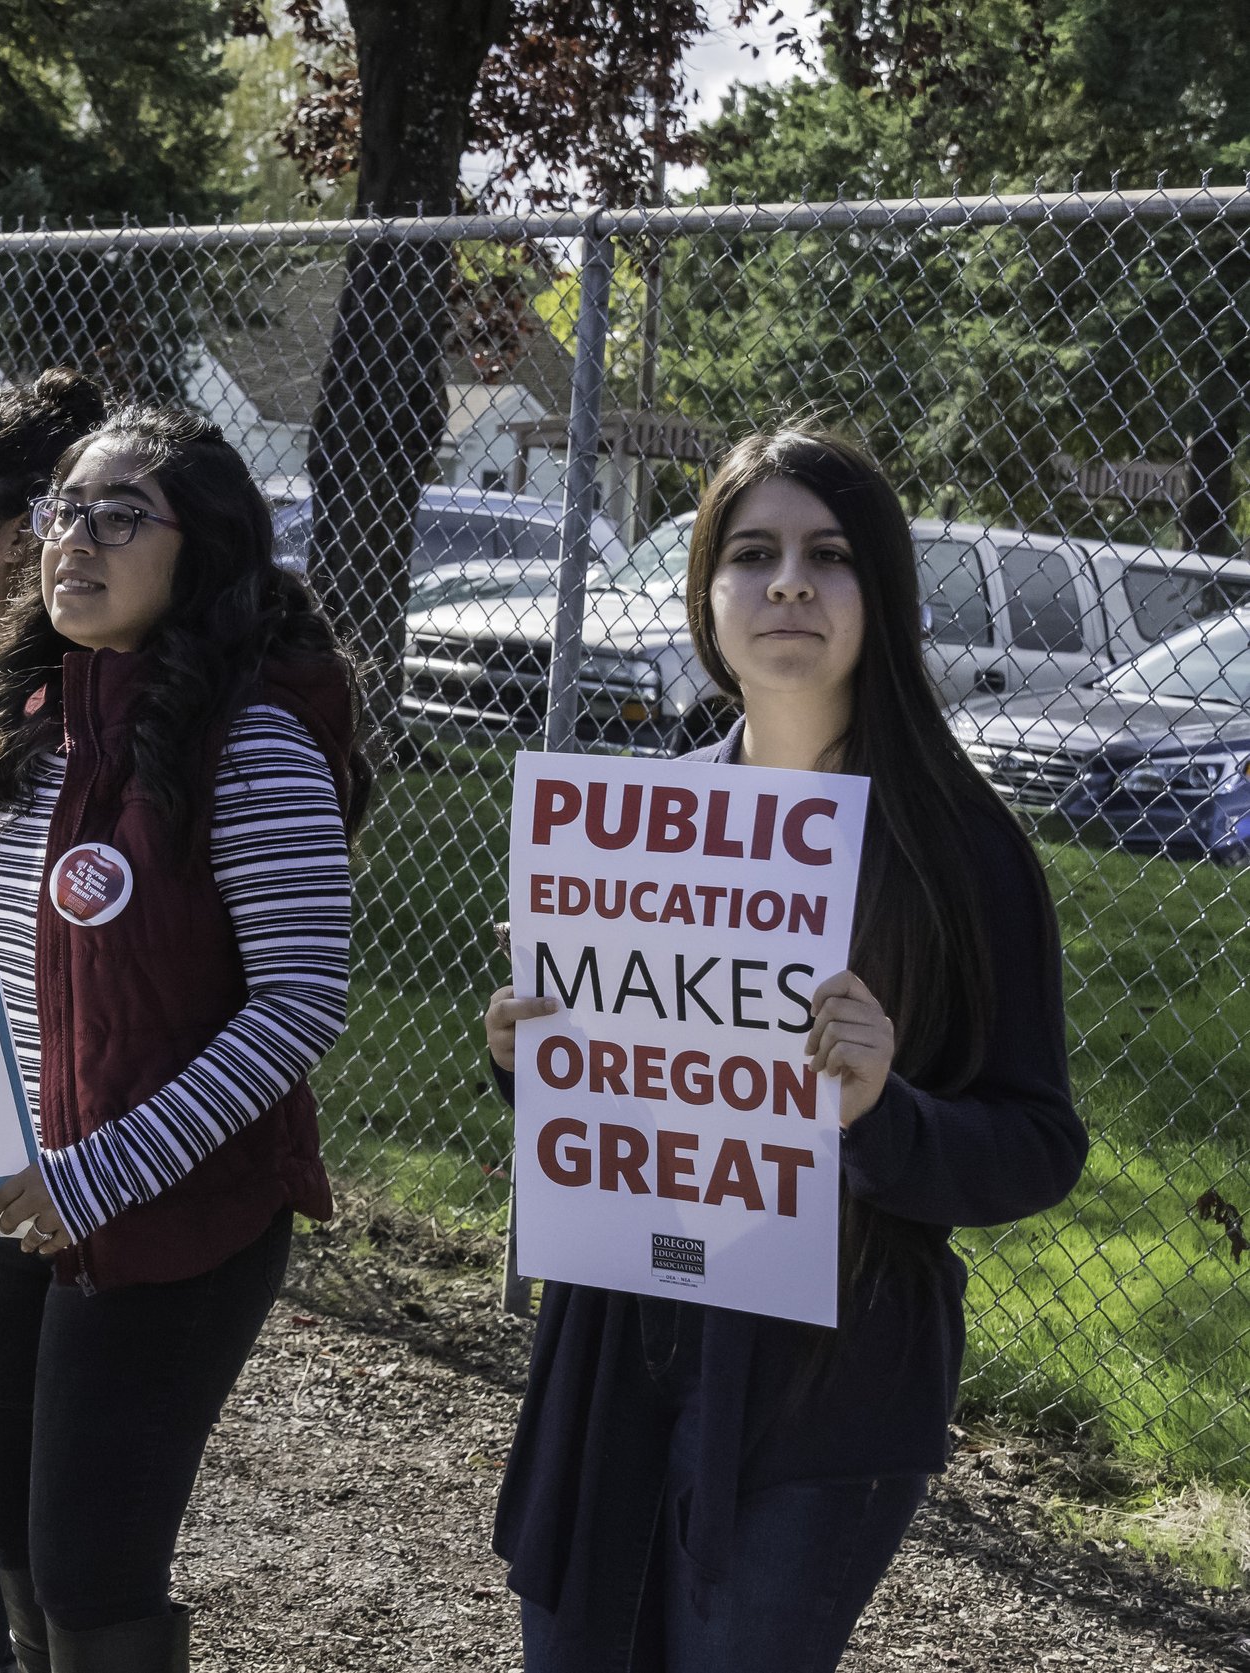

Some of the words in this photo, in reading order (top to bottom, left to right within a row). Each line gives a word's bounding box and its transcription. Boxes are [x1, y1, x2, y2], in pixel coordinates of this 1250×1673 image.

[531, 778, 838, 867] PUBLIC
[530, 874, 828, 936] EDUCATION
[535, 941, 815, 1034] MAKES
[536, 1035, 817, 1120] OREGON
[536, 1117, 815, 1218] GREAT
[653, 1235, 703, 1252] OREGON
[654, 1248, 703, 1263] EDUCATION
[654, 1260, 703, 1273] ASSOCIATION
